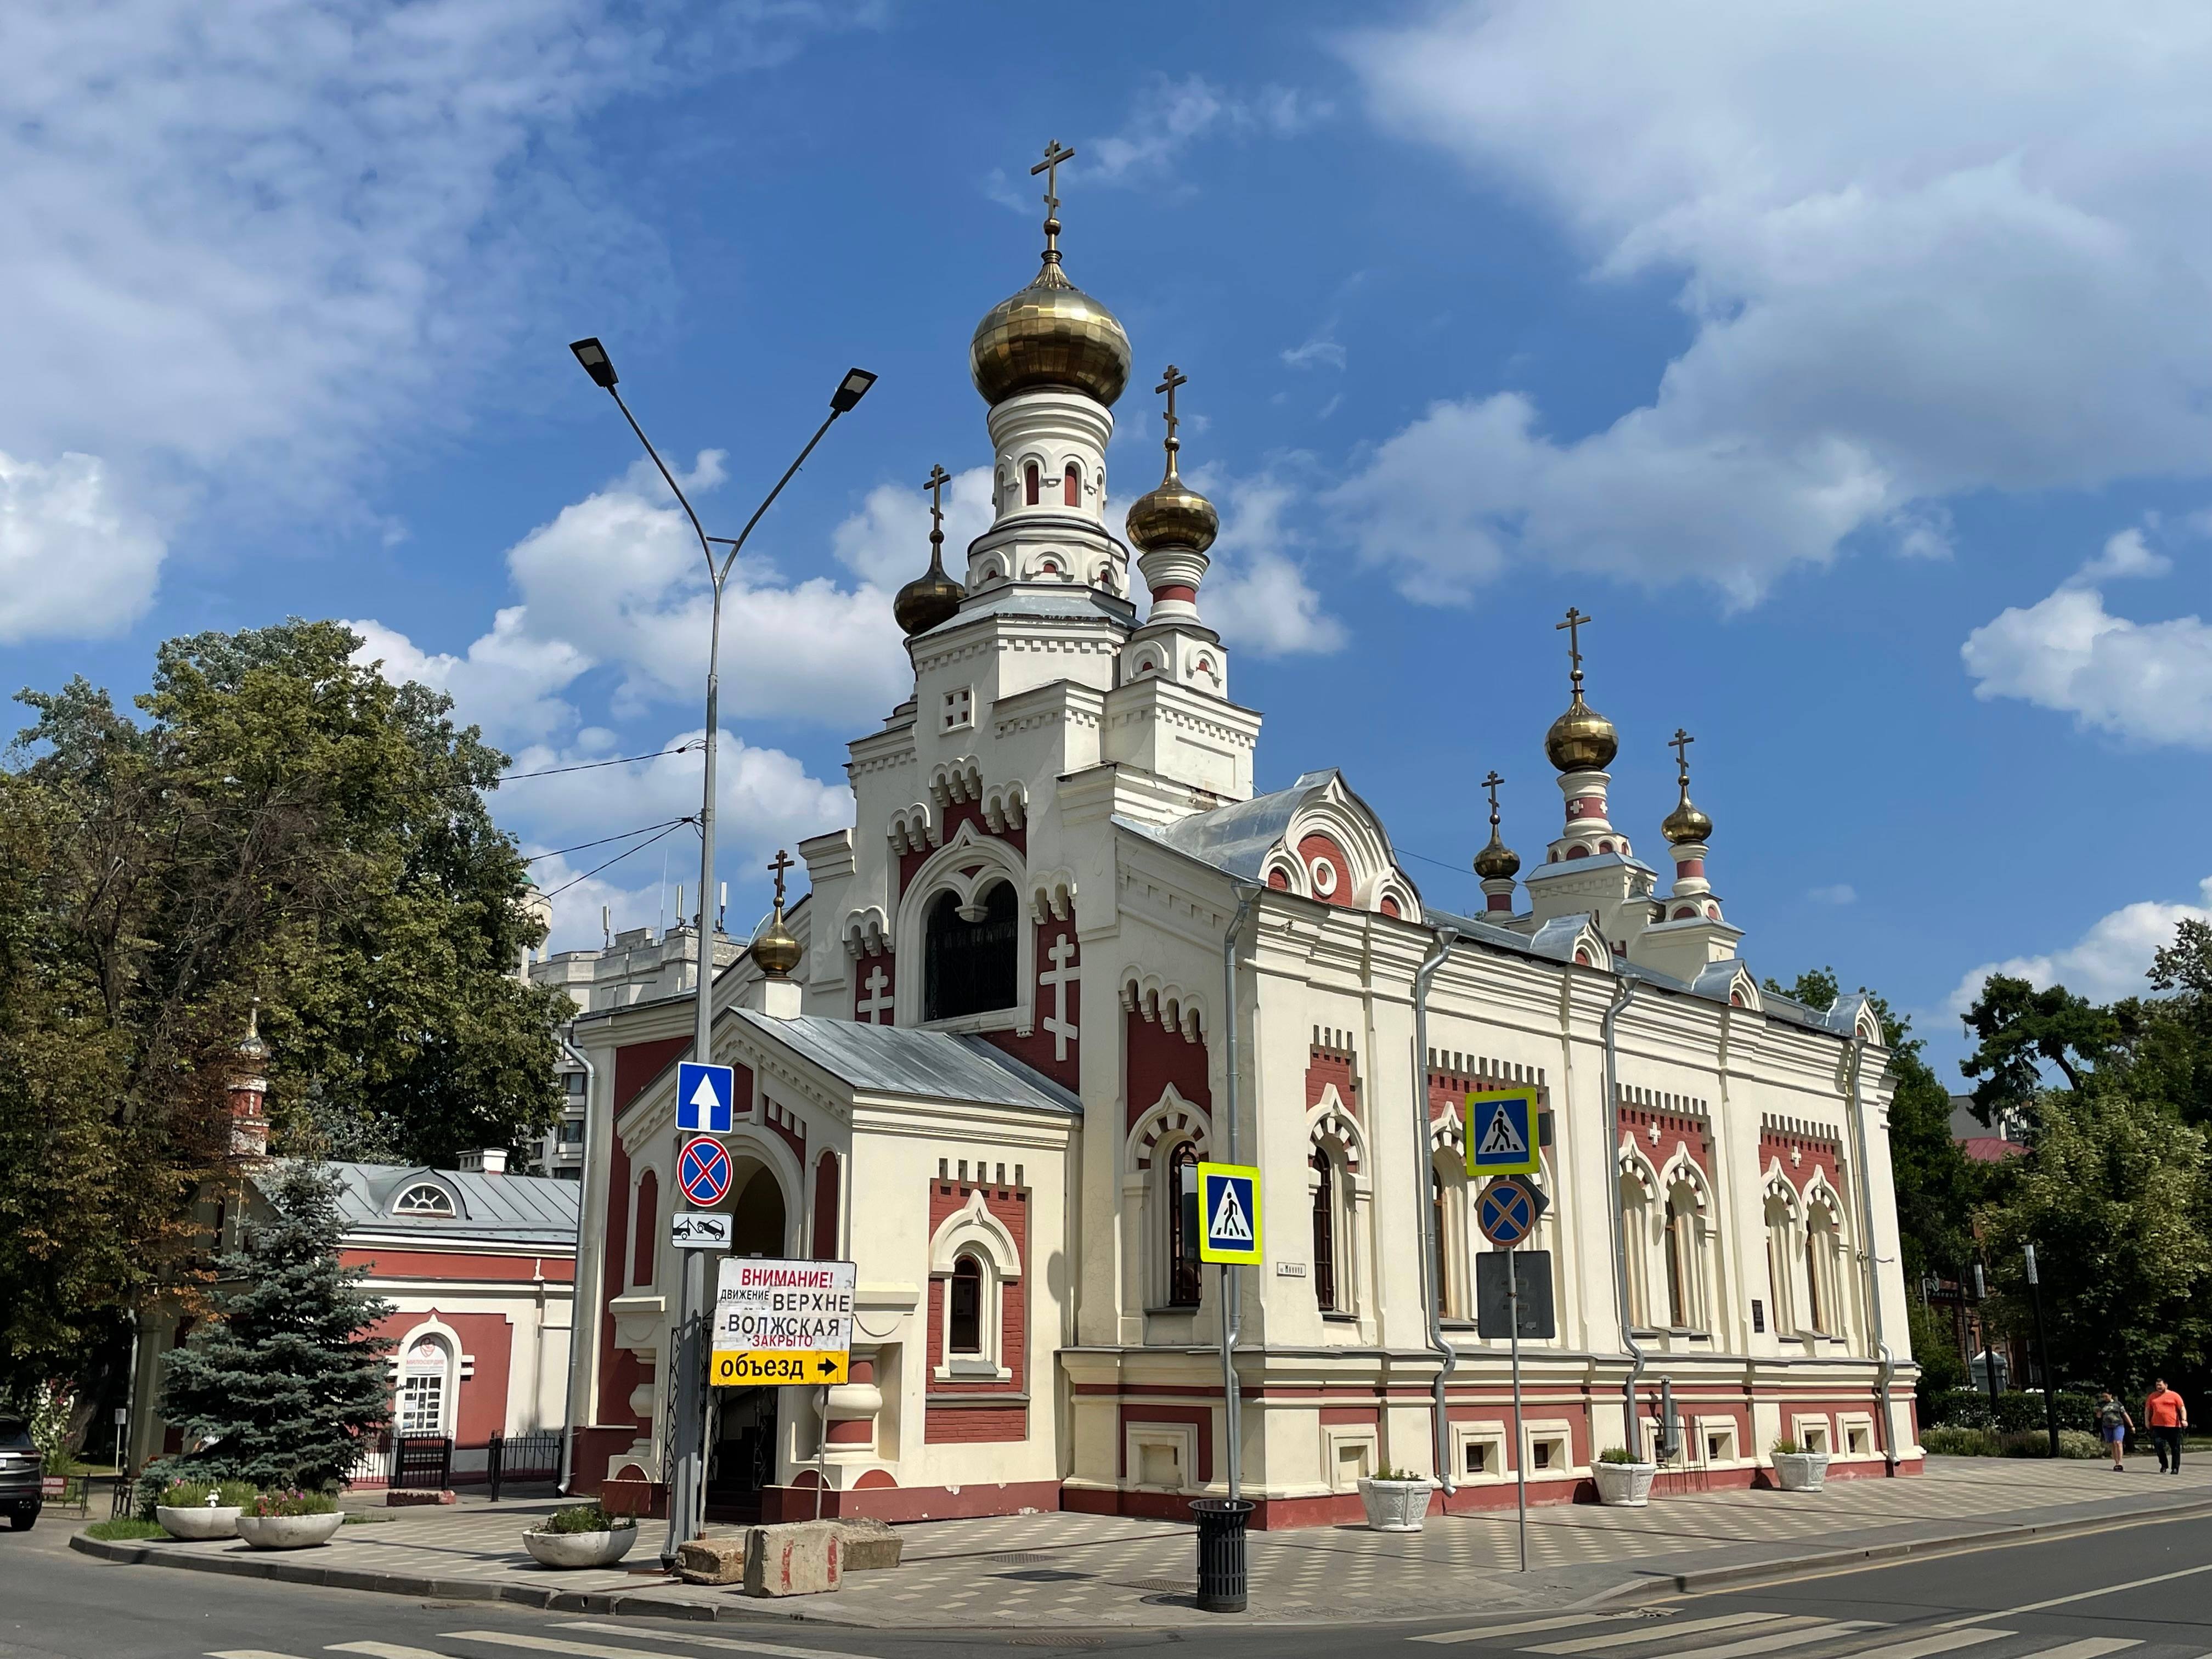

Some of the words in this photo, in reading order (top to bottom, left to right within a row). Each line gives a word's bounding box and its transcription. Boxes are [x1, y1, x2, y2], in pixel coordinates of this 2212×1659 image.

[742, 1268, 833, 1288] ВНИМАНИЕ!
[720, 1289, 770, 1301] ДВИЖЕНИЕ
[773, 1294, 850, 1312] ВЕРХНЕ
[752, 1335, 813, 1347] ЗАКРЫТО
[720, 1353, 804, 1380] объезд
